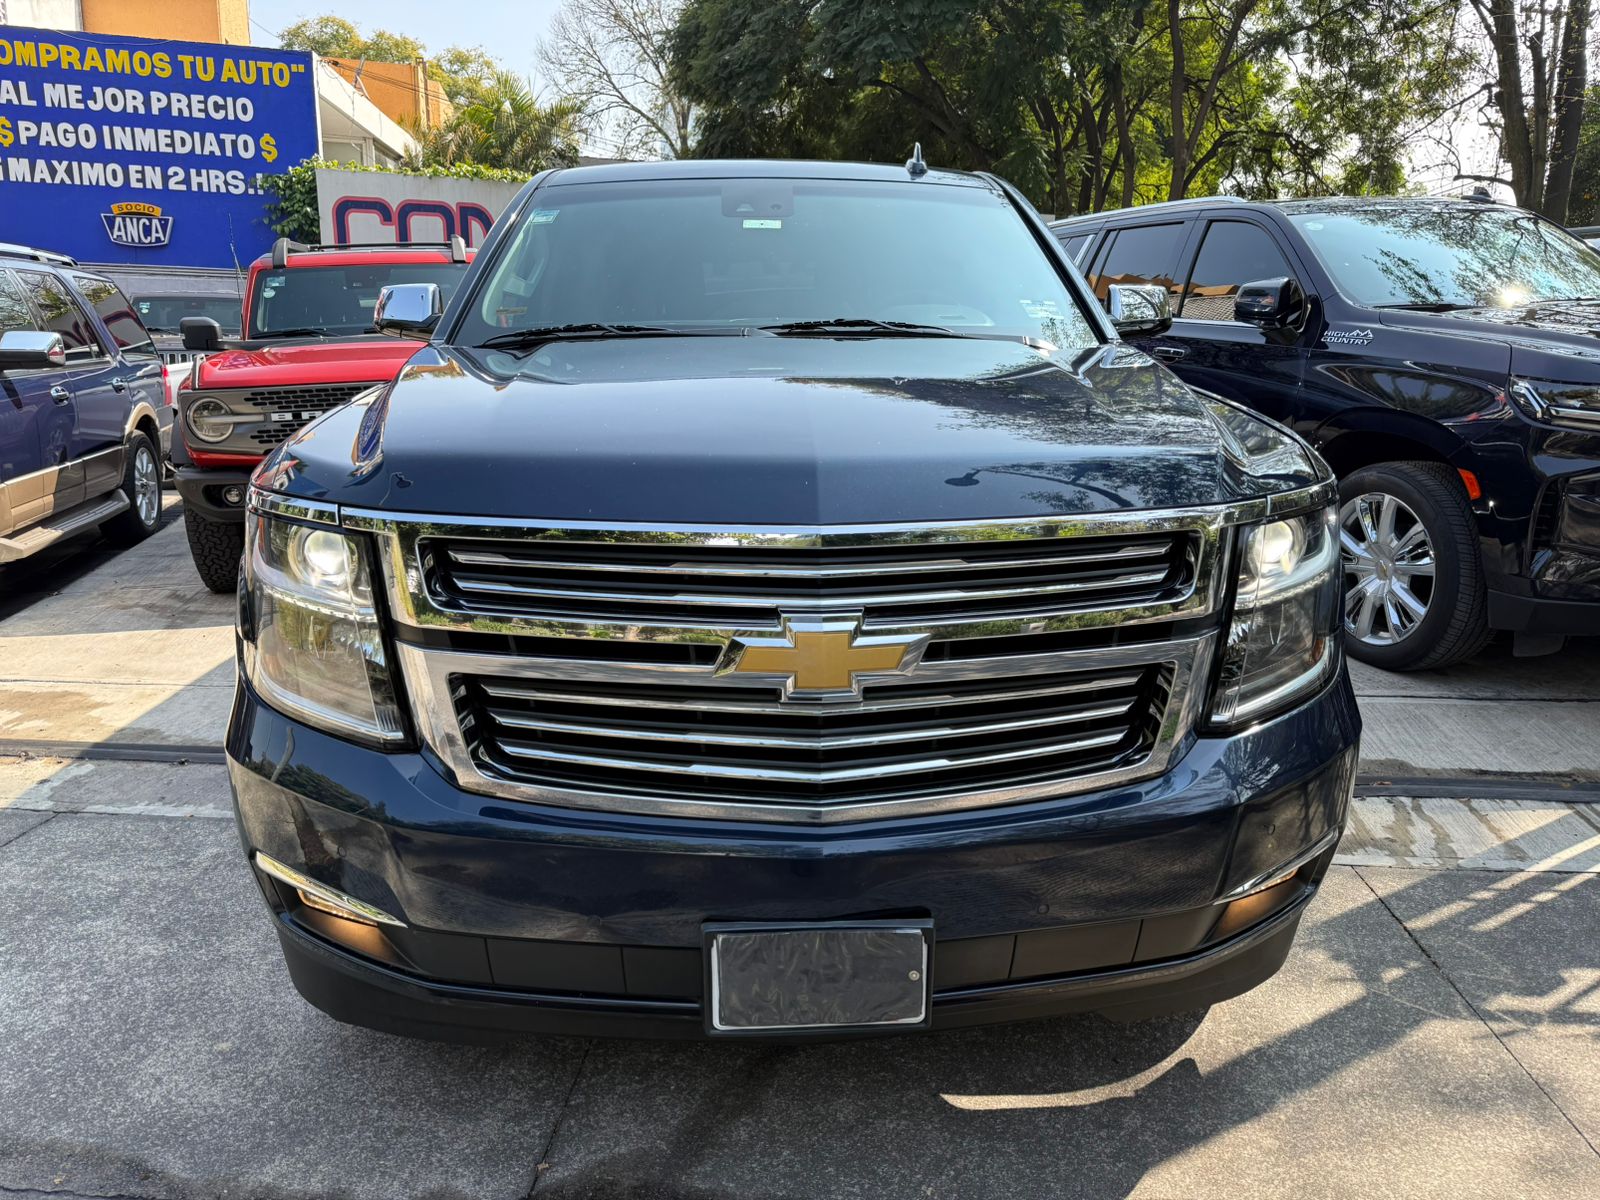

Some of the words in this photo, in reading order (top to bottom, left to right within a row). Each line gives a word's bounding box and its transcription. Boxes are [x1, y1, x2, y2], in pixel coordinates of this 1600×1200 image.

[178, 54, 215, 82] TU
[0, 80, 37, 107] AL
[150, 91, 254, 122] PRECIO
[17, 120, 97, 149] PAGO
[102, 125, 256, 160] INMEDIATO
[259, 133, 278, 163] $
[128, 164, 163, 190] EN
[168, 167, 187, 191] 2
[117, 203, 155, 213] SOCIO
[113, 216, 165, 244] ANCA
[1320, 336, 1371, 345] COUNTRY
